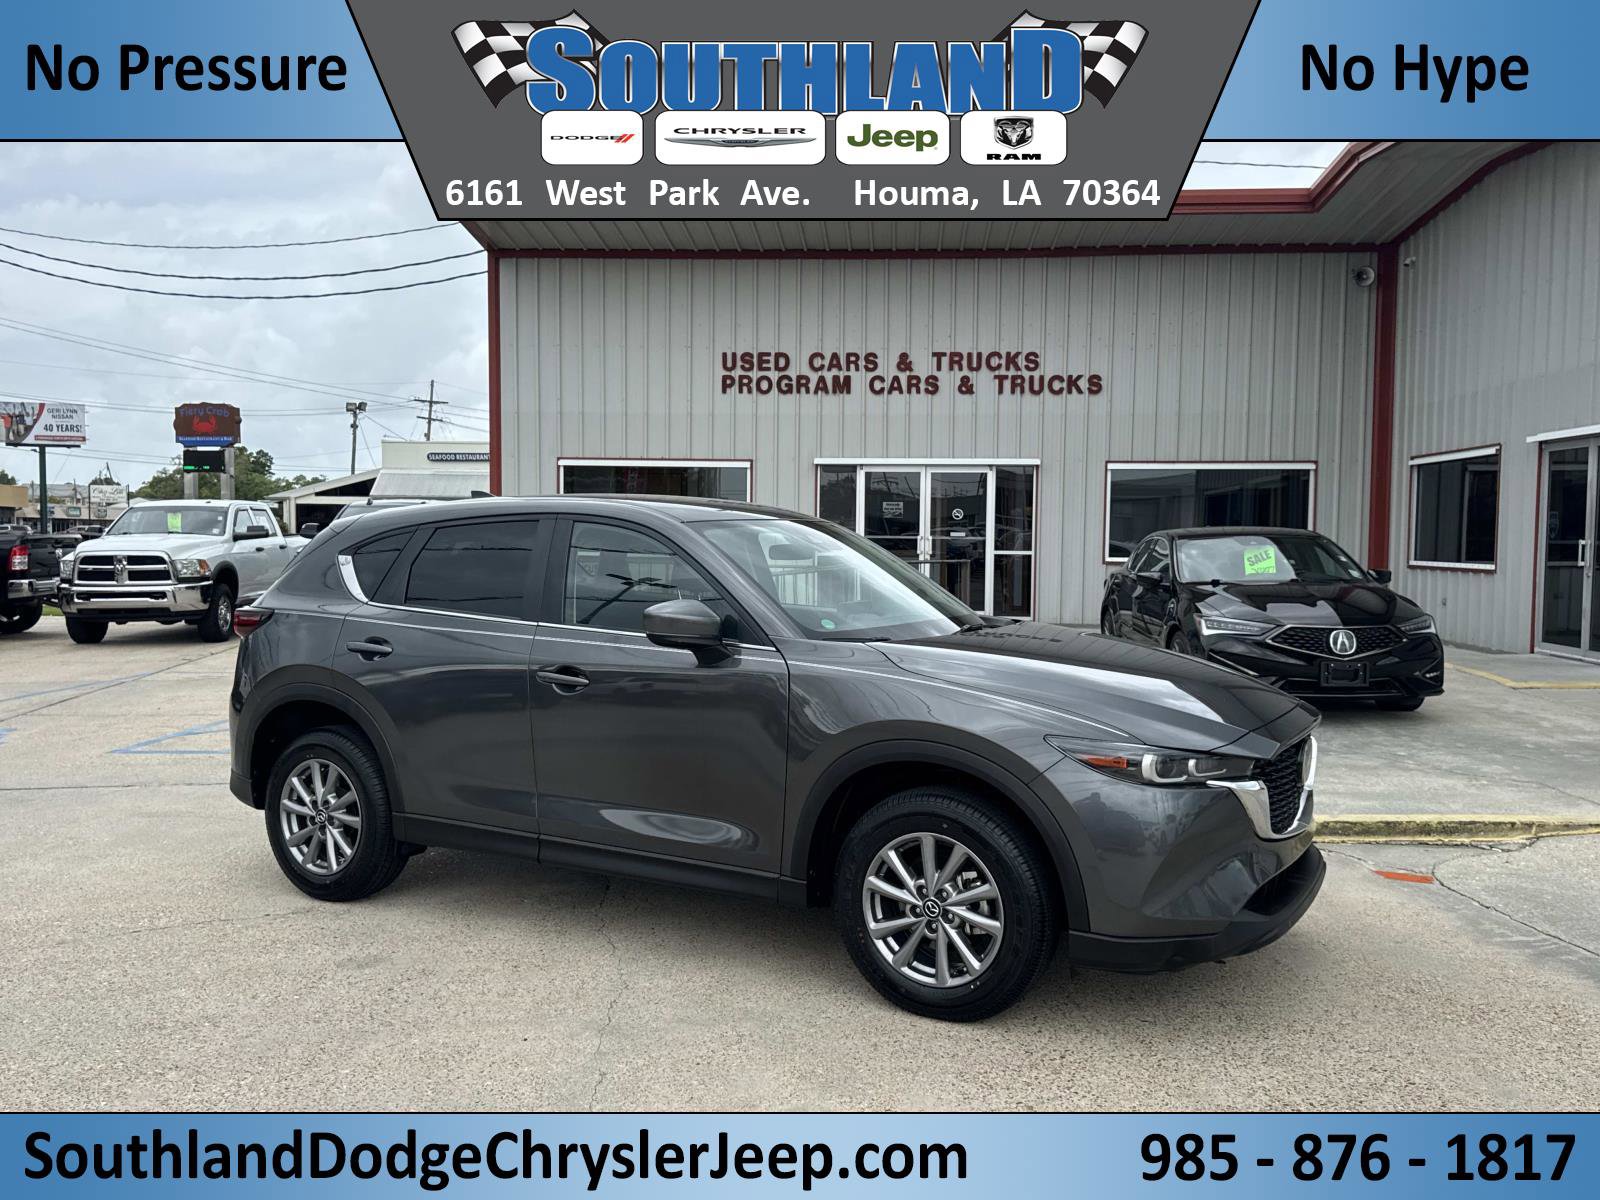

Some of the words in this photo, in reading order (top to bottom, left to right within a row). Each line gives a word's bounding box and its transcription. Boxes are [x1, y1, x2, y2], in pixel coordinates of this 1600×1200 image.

[721, 351, 790, 372] USED
[808, 351, 878, 372] CARS
[896, 351, 914, 372] &
[932, 350, 1040, 372] TRUCKS
[721, 374, 852, 395] PROGRAM
[869, 374, 940, 395] CARS
[957, 375, 975, 395] &
[994, 373, 1103, 395] TRUCKS
[43, 423, 54, 432] 40
[1246, 549, 1272, 567] SALE
